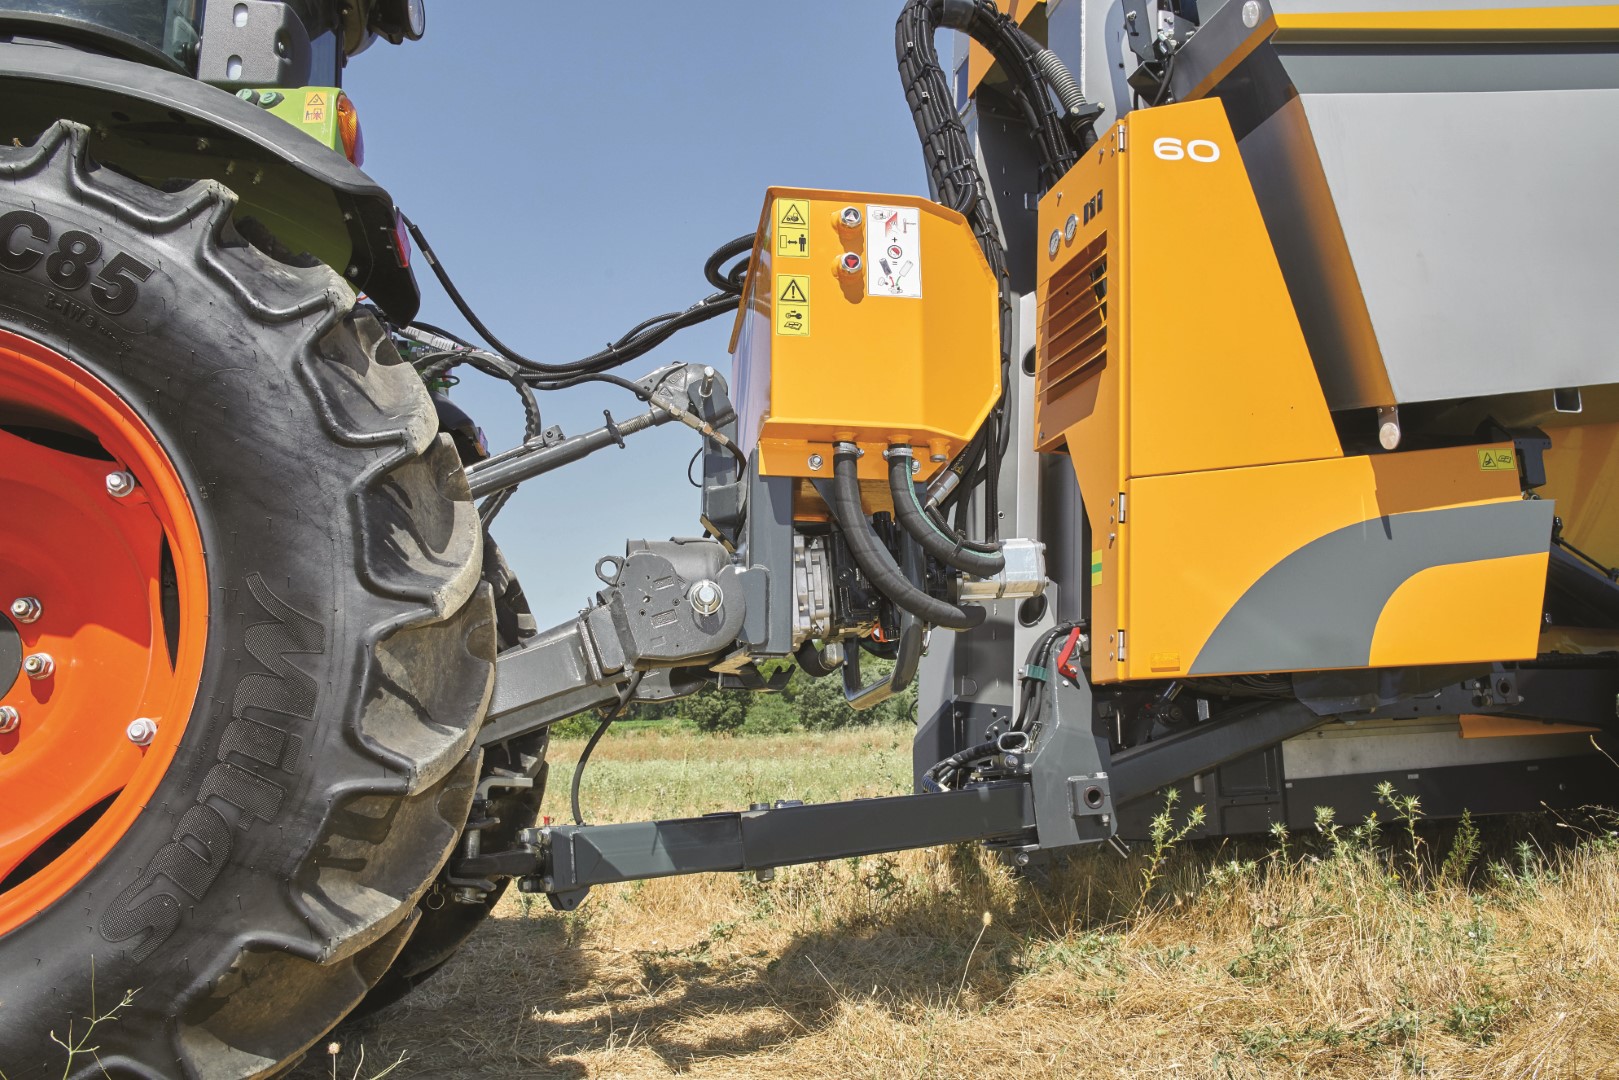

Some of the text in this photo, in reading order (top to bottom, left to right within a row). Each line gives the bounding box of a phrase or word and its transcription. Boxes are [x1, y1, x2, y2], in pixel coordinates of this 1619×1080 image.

[1153, 137, 1220, 163] 60
[0, 210, 154, 315] C85
[99, 571, 325, 964] Mitas
